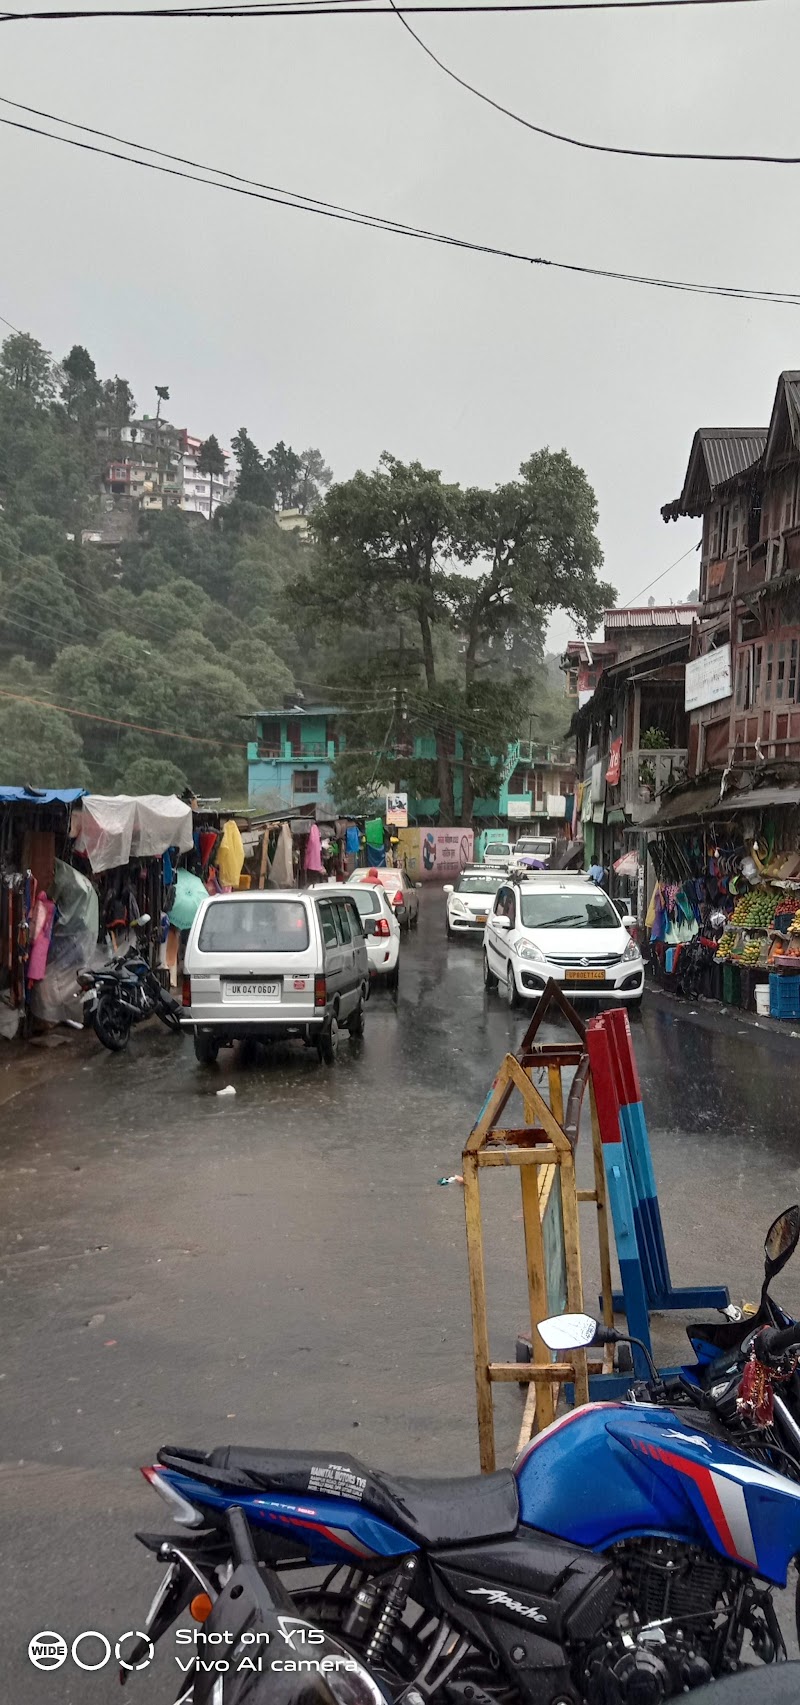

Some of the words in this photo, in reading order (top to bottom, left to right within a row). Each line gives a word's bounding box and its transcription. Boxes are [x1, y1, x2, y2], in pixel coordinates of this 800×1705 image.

[334, 1470, 356, 1485] MOTORS
[355, 1476, 367, 1489] TVS
[465, 1587, 548, 1623] Apache
